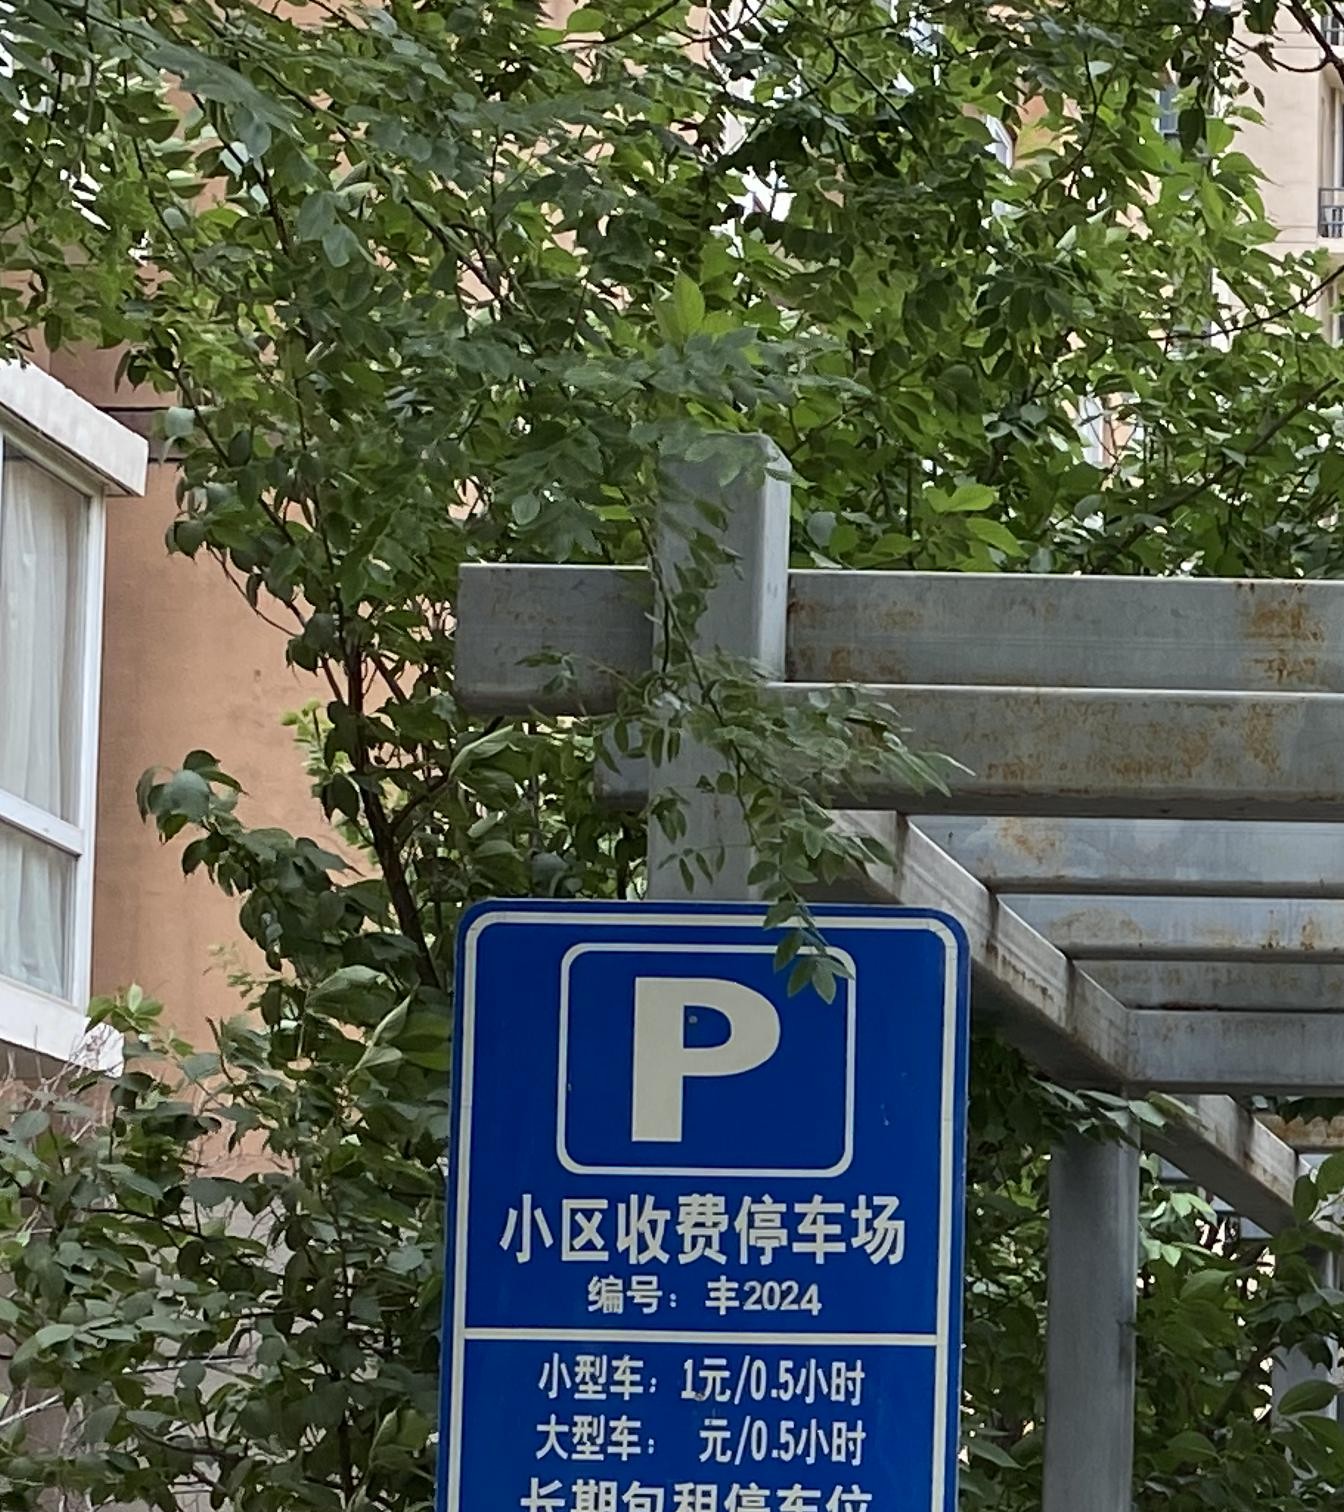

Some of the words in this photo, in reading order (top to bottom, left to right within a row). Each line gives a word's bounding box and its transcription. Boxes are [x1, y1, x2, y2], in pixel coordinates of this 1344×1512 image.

[631, 976, 781, 1143] P
[500, 1193, 906, 1266] 小区收费停车场
[586, 1275, 823, 1316] 编号：丰2024
